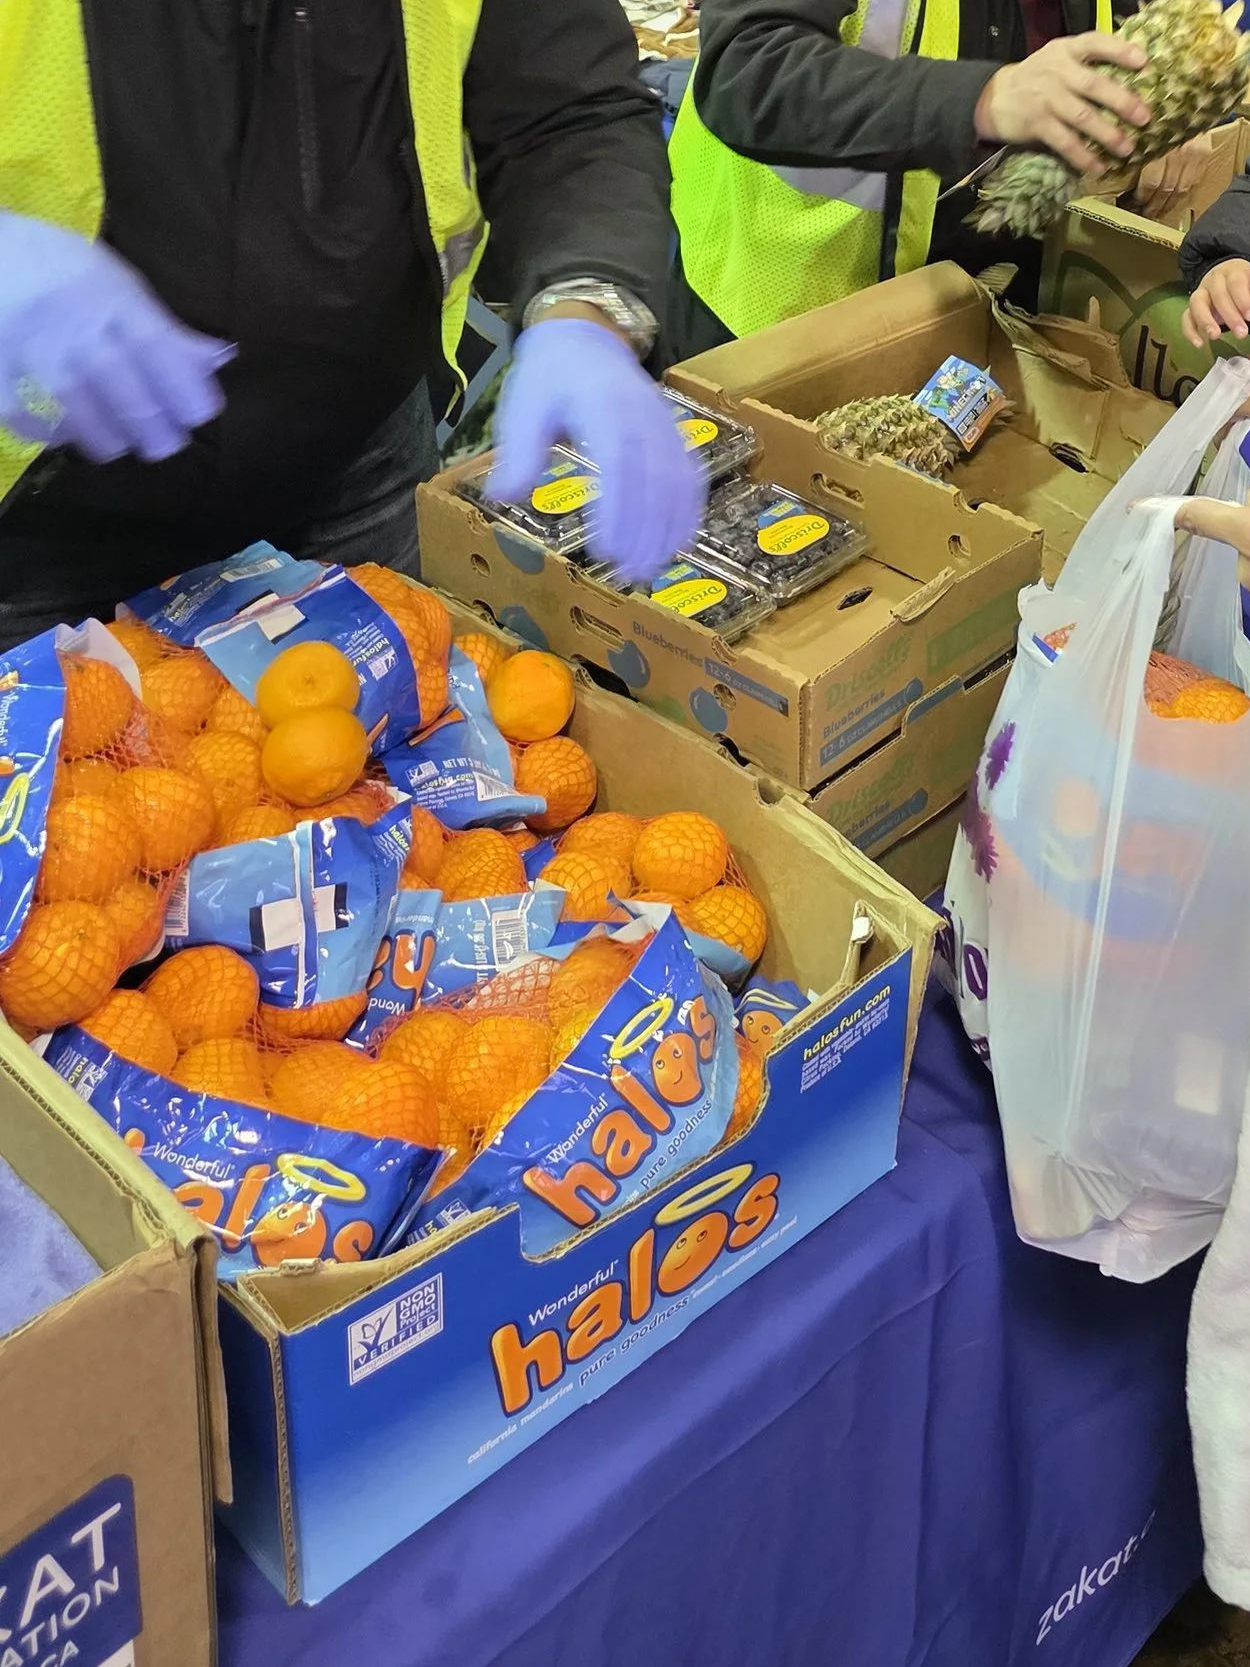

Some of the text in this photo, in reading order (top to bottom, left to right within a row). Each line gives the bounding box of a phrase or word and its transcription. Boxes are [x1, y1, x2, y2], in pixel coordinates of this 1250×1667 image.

[768, 517, 827, 554] Driscoll's
[632, 620, 704, 667] Blueberries
[823, 688, 886, 737] Blueberries
[803, 985, 891, 1061] halosfun.com
[520, 994, 717, 1230] halos
[545, 1095, 607, 1165] Wonderful
[153, 1141, 234, 1182] Wonderful
[640, 1098, 714, 1192] pure goodness
[400, 1282, 435, 1311] NON
[400, 1293, 436, 1320] GMO
[400, 1302, 436, 1329] Project
[489, 1172, 781, 1416] halos
[528, 1262, 616, 1326] Wonderful
[358, 1314, 436, 1366] VERIFIED
[579, 1348, 616, 1386] pure
[620, 1296, 689, 1354] goodness
